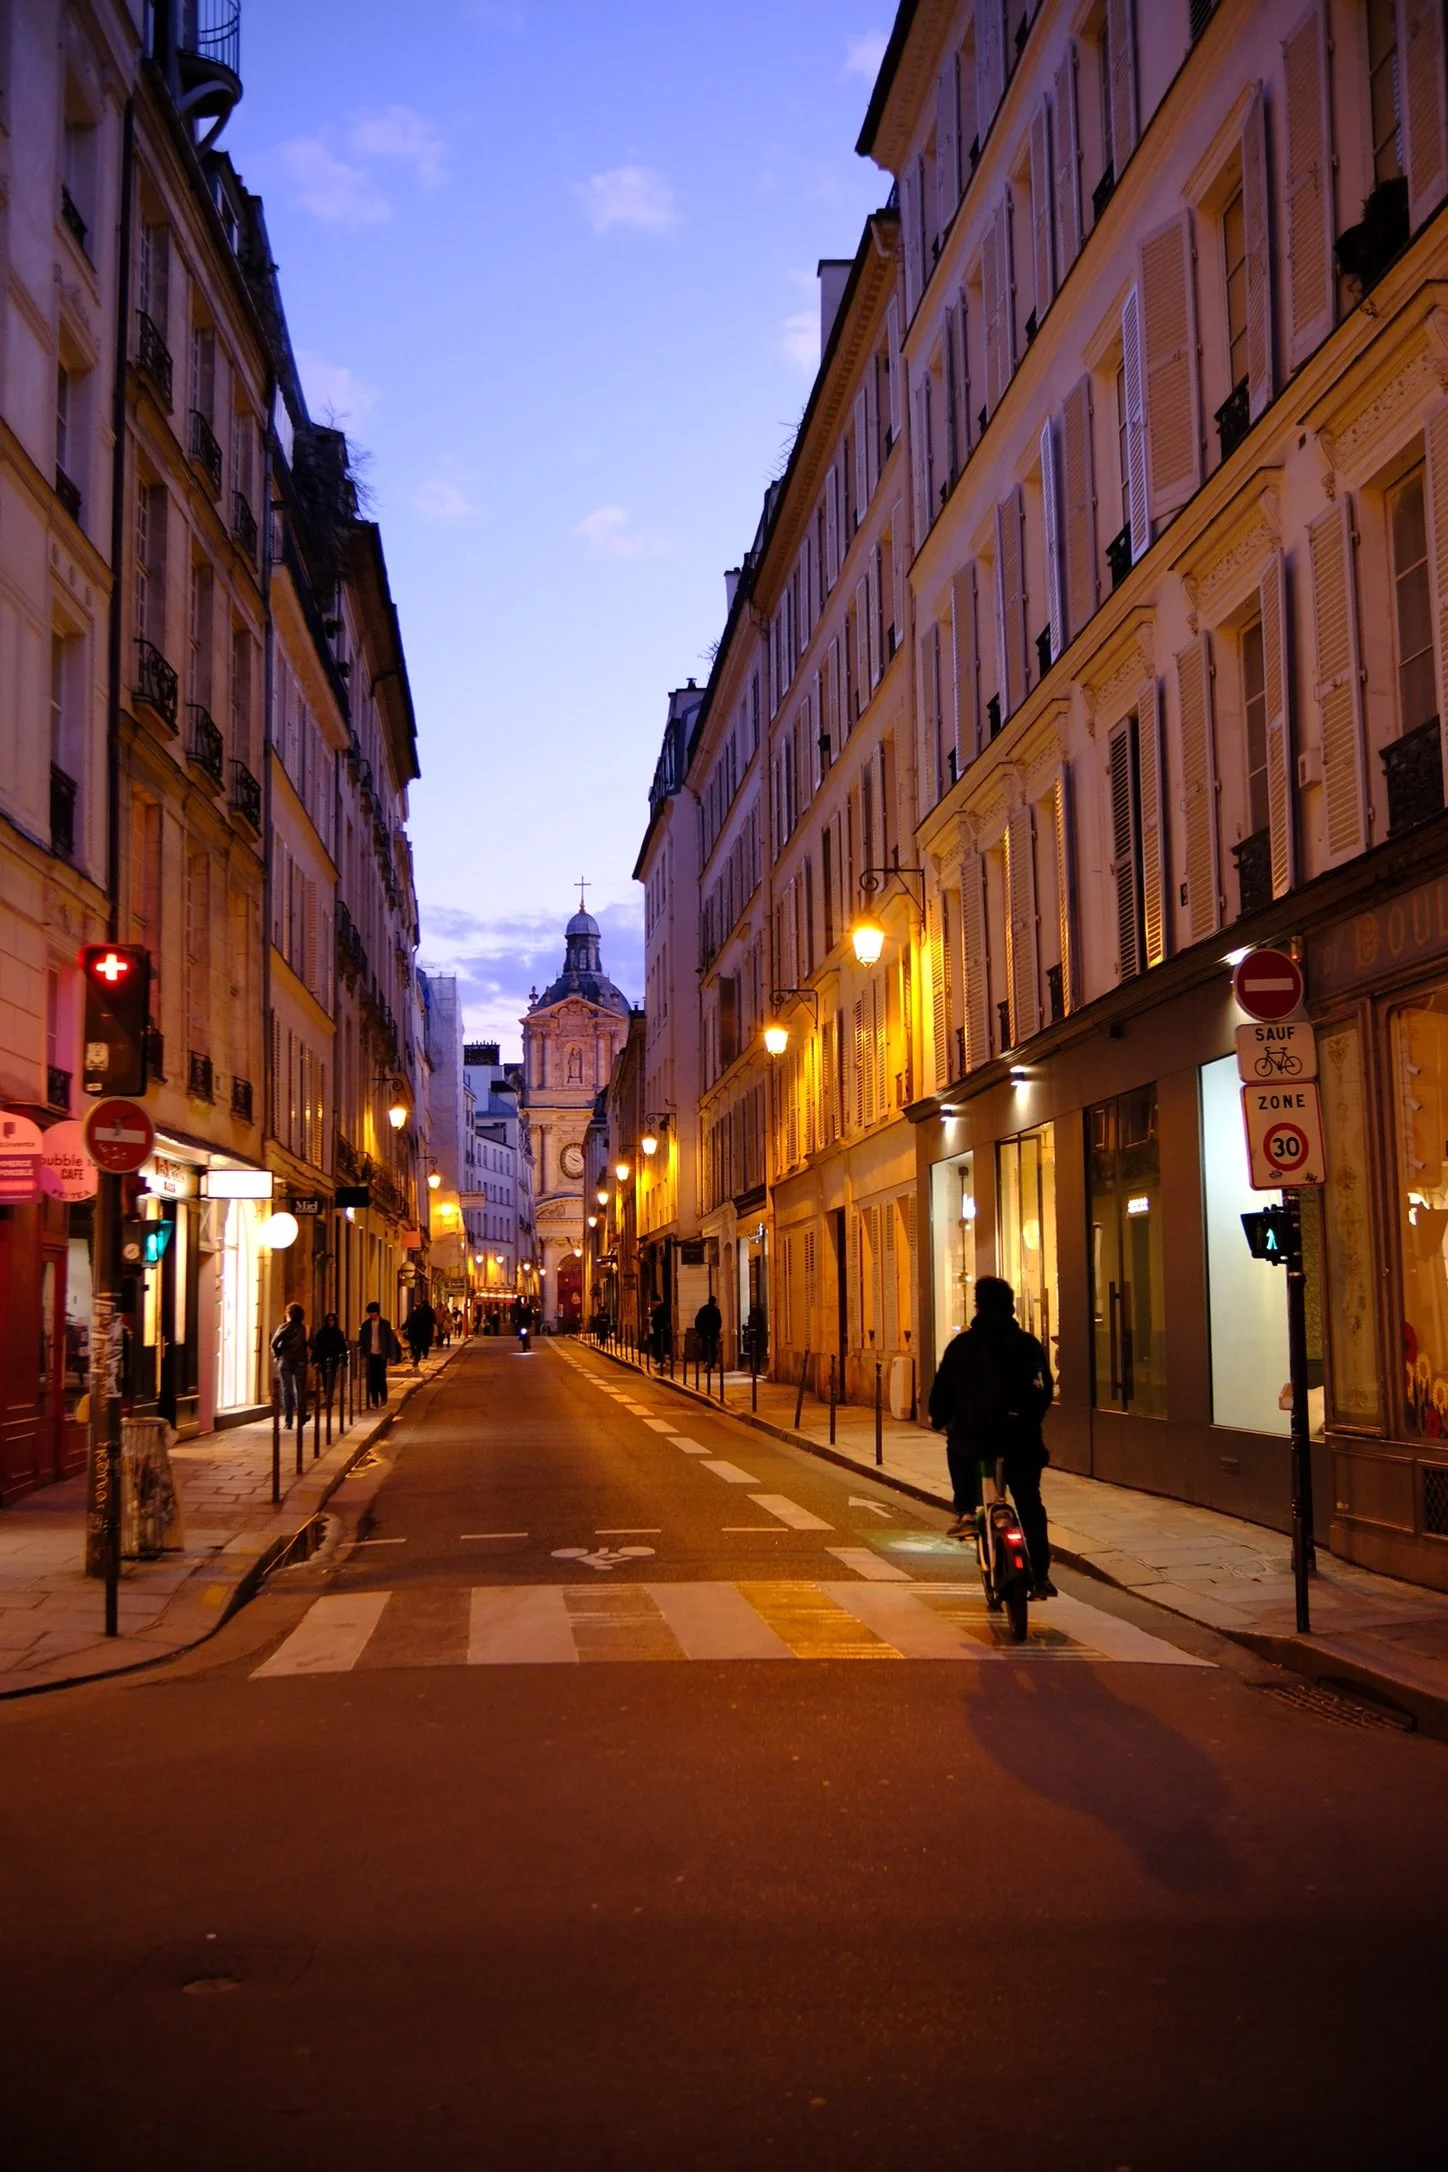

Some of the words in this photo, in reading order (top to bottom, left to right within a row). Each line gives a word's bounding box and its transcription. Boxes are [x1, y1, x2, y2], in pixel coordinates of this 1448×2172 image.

[1255, 1026, 1296, 1042] SAUF
[1258, 1094, 1306, 1110] ZONE
[1272, 1136, 1301, 1158] 30
[296, 1200, 318, 1210] Miel
